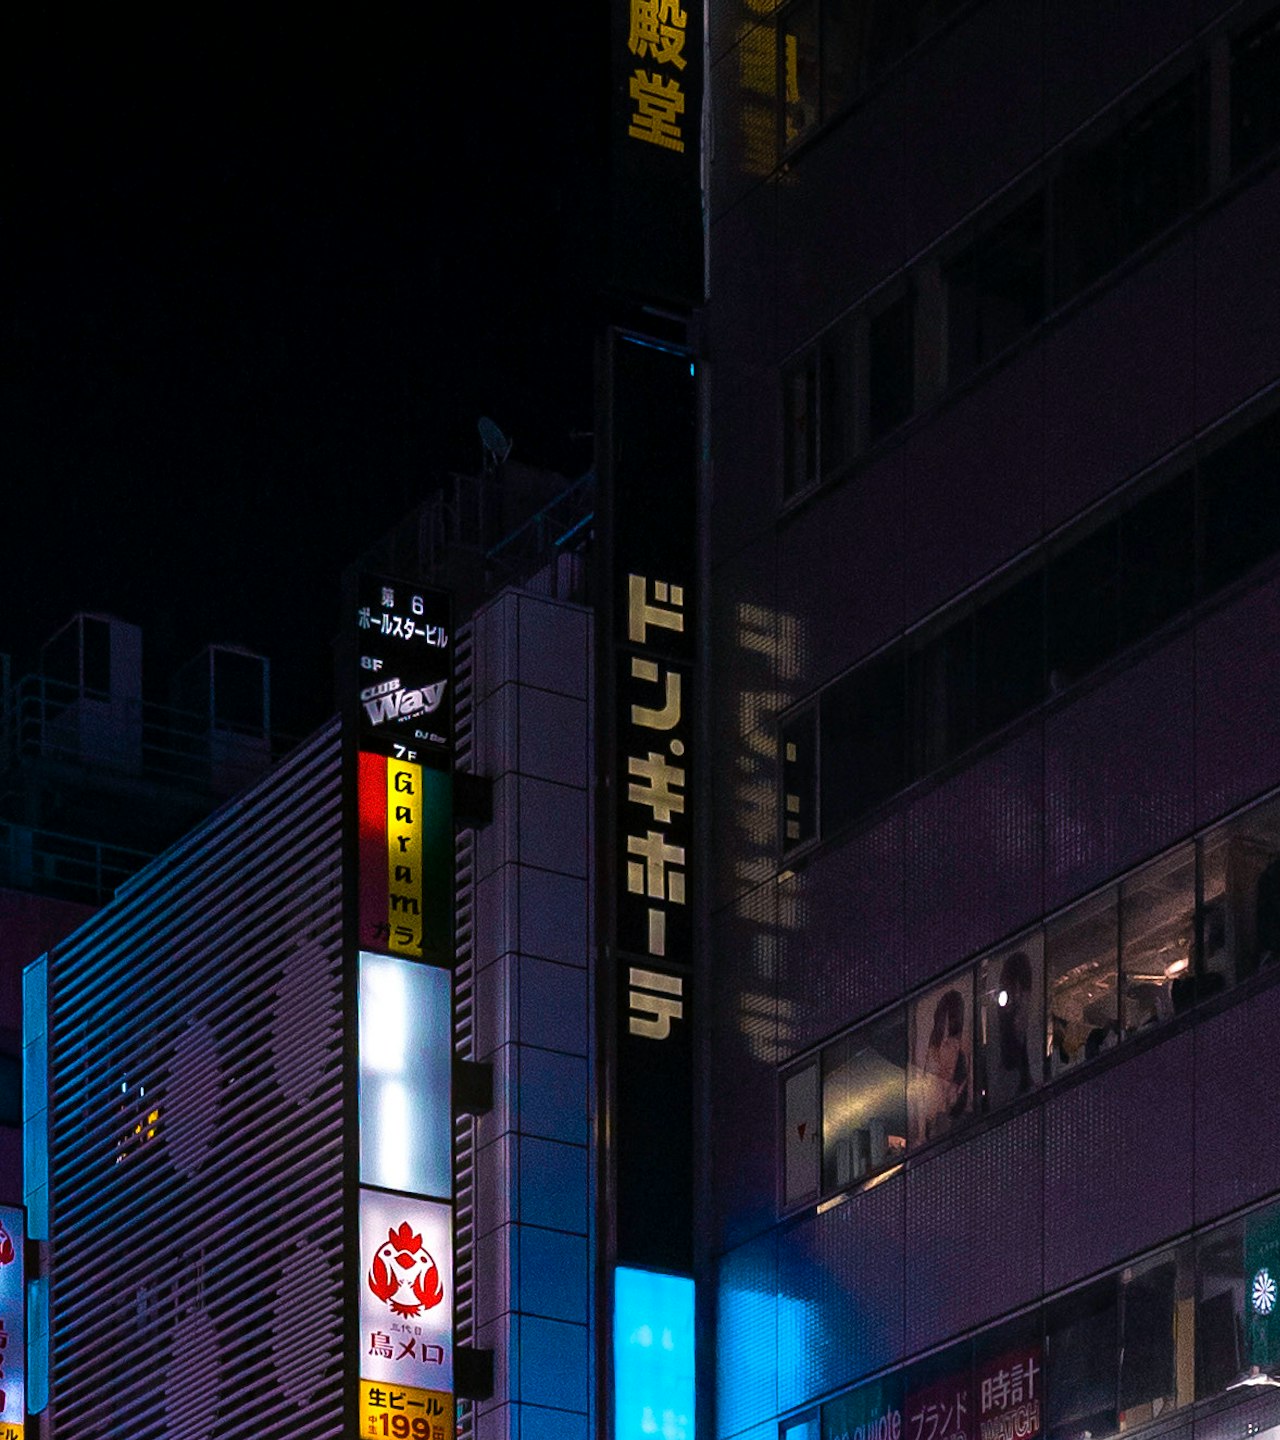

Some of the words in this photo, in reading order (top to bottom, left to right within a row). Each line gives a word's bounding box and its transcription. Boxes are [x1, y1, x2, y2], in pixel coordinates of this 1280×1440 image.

[393, 743, 418, 761] 7F
[627, 574, 686, 1042] ドン・キホーテ
[390, 770, 420, 916] Garam
[368, 1330, 444, 1365] 鳥メロ
[368, 1387, 444, 1416] 生ビール
[980, 1357, 1041, 1415] 時計
